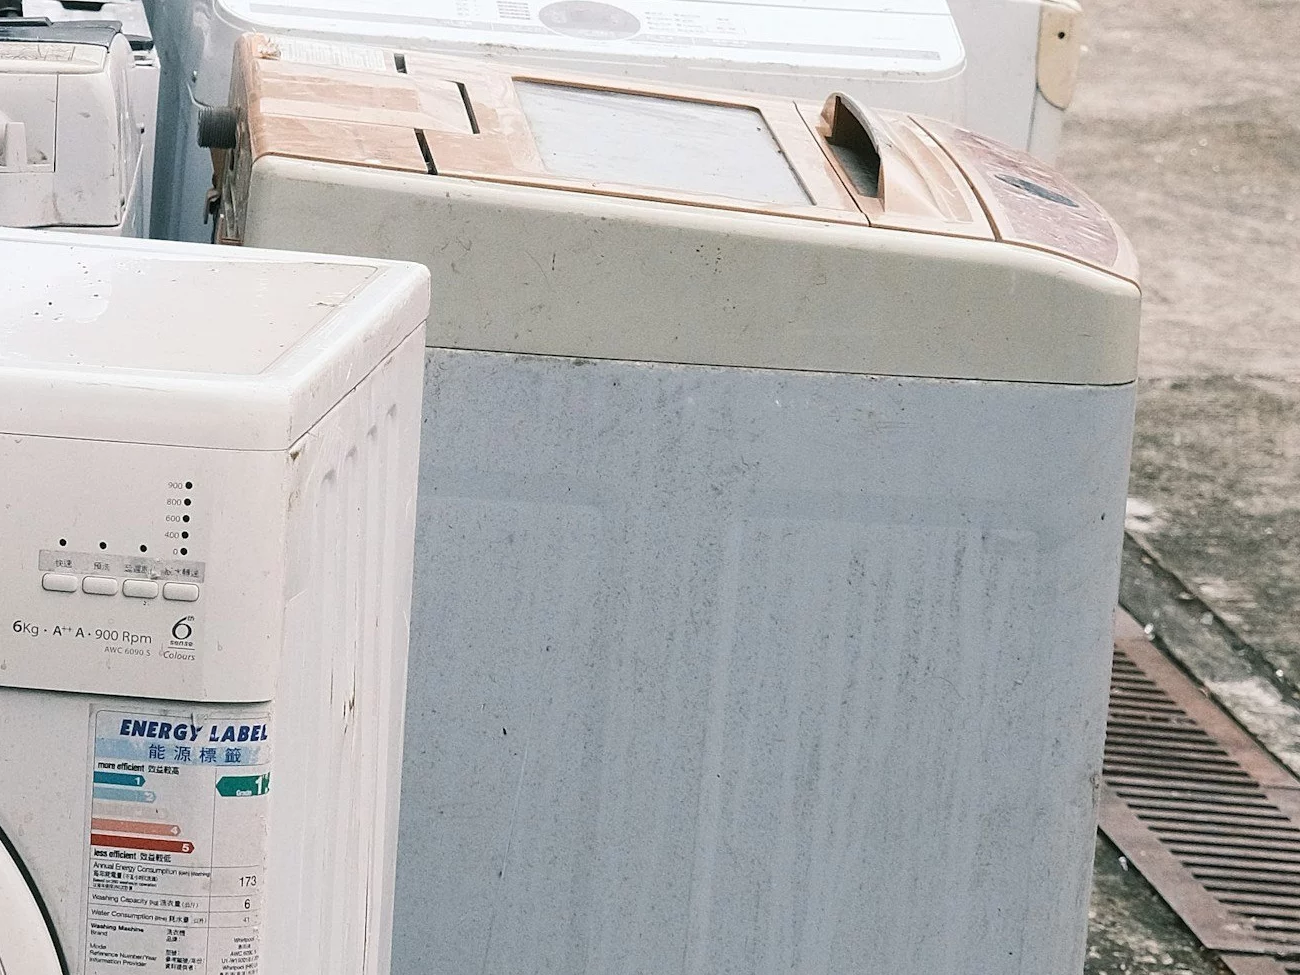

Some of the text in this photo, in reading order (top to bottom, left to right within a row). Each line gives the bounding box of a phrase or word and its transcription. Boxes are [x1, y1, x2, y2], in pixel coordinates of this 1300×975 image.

[167, 481, 183, 490] 900
[166, 498, 182, 506] 800
[165, 514, 181, 523] 600
[164, 531, 180, 539] 400
[12, 620, 39, 637] 6Kg
[95, 629, 119, 641] 900
[122, 631, 152, 645] Rpm
[104, 646, 122, 654] AWC
[163, 651, 196, 661] Colours
[119, 719, 268, 742] ENERGY LABEL
[148, 743, 242, 764] 能源標籤
[117, 763, 145, 772] efficient
[170, 826, 178, 835] 4
[181, 843, 190, 852] 5
[94, 848, 108, 857] less
[109, 850, 137, 860] efficient
[93, 861, 114, 870] Annual
[115, 863, 136, 873] Energy
[137, 865, 178, 876] Consumption
[239, 875, 257, 887] 173
[92, 894, 118, 903] Washing
[120, 896, 148, 906] Capacity
[244, 898, 251, 909] 6
[111, 911, 153, 921] Consumption
[90, 923, 116, 931] Washing
[118, 925, 144, 933] Machine
